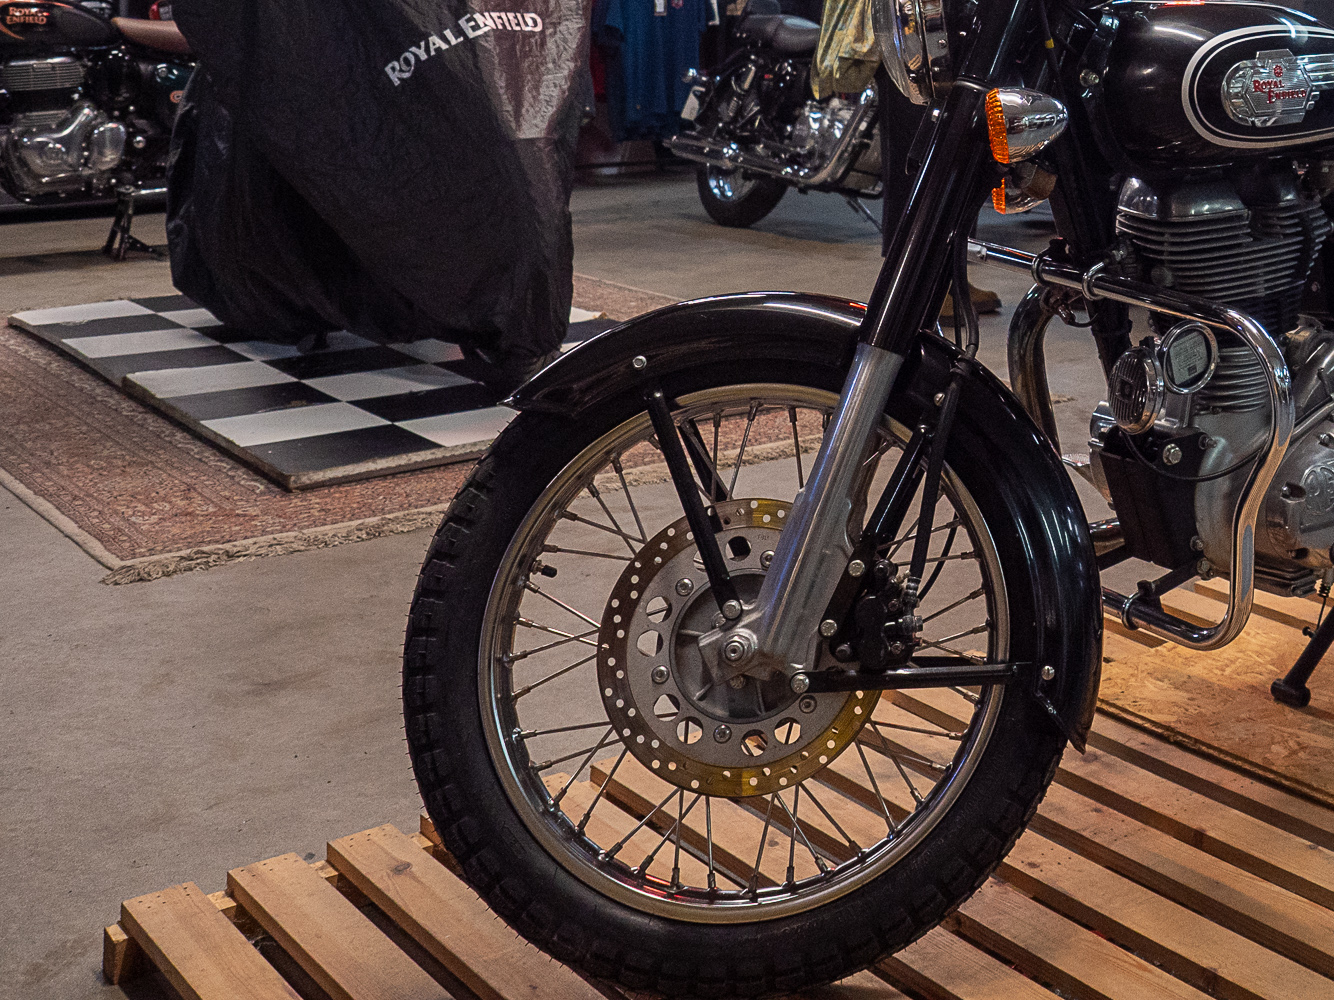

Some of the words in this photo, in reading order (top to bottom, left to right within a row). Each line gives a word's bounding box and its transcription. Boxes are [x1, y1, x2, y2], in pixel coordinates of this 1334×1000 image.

[6, 15, 47, 25] ENFIELD
[384, 28, 464, 87] ROYAL
[458, 11, 543, 39] ENFIELD
[1252, 79, 1285, 94] ROYAL
[1266, 89, 1307, 104] ENFIELD
